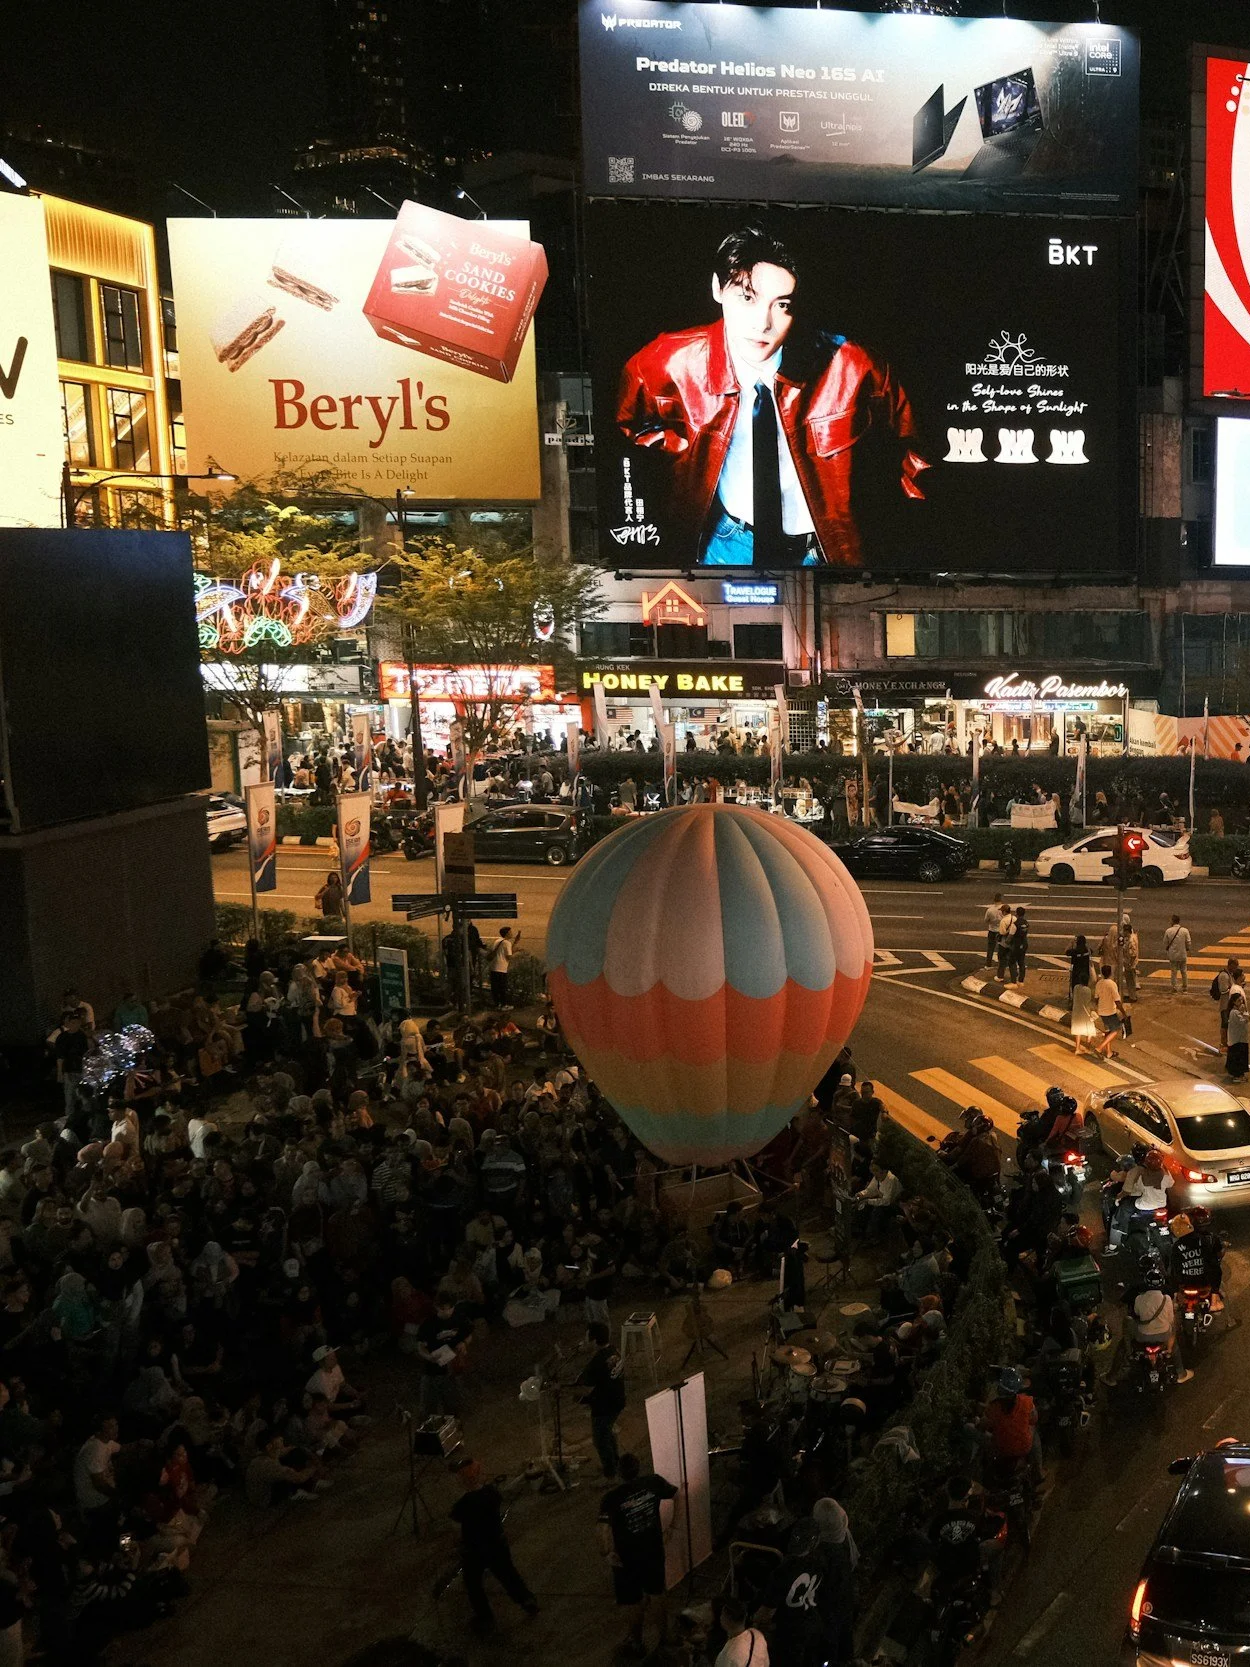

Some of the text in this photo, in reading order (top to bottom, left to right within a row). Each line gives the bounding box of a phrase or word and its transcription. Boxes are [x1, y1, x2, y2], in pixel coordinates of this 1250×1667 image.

[618, 18, 682, 31] PREDATOR
[1089, 42, 1110, 52] intel
[636, 57, 885, 83] Predator Helios Neo 16S AI
[649, 82, 874, 102] DIREKA BENTUK UNTUK PRESTASI UNGGUL
[721, 111, 745, 129] OLED
[642, 173, 715, 183] IMBAS SEKARANG
[468, 242, 516, 266] Beryl's
[462, 261, 506, 284] SAND
[444, 269, 516, 302] COOKIES
[965, 363, 1069, 377] 阳光是爱自己的形状
[971, 383, 1064, 399] Self-love Shines
[268, 378, 451, 449] Beryl's
[946, 400, 1088, 417] in the Shape of Sunlight
[273, 452, 452, 468] Kelazatan dalam Setiap Suapan
[335, 469, 358, 480] Bite
[361, 470, 371, 480] Is
[374, 470, 384, 480] A
[386, 469, 428, 484] Delight
[724, 584, 777, 595] TRAVELOGUE
[583, 673, 743, 691] HONEY BAKE
[855, 681, 946, 690] MONEY EXCHANGE
[1039, 675, 1129, 698] Pasembor
[1182, 1249, 1201, 1259] YOU
[1191, 1653, 1228, 1667] SS6193X
